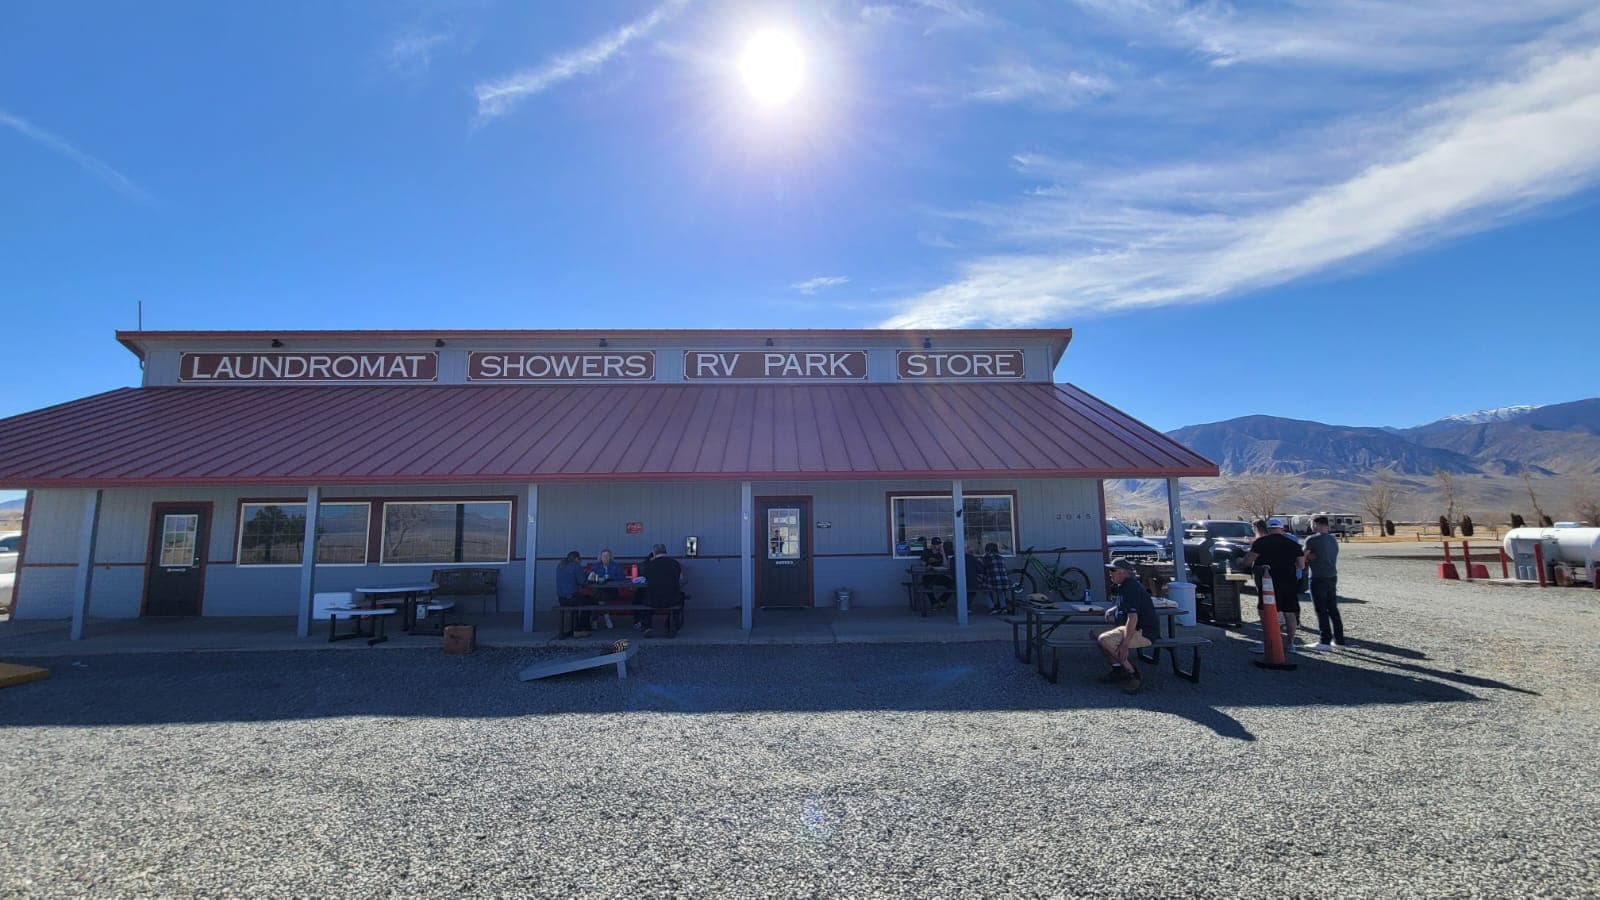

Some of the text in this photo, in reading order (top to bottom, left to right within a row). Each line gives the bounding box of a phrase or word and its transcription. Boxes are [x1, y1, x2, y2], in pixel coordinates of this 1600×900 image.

[192, 355, 427, 379] LAUNDROMAT
[479, 355, 647, 377] SHOWERS
[695, 353, 853, 377] RV PARK
[906, 353, 1016, 377] STORE
